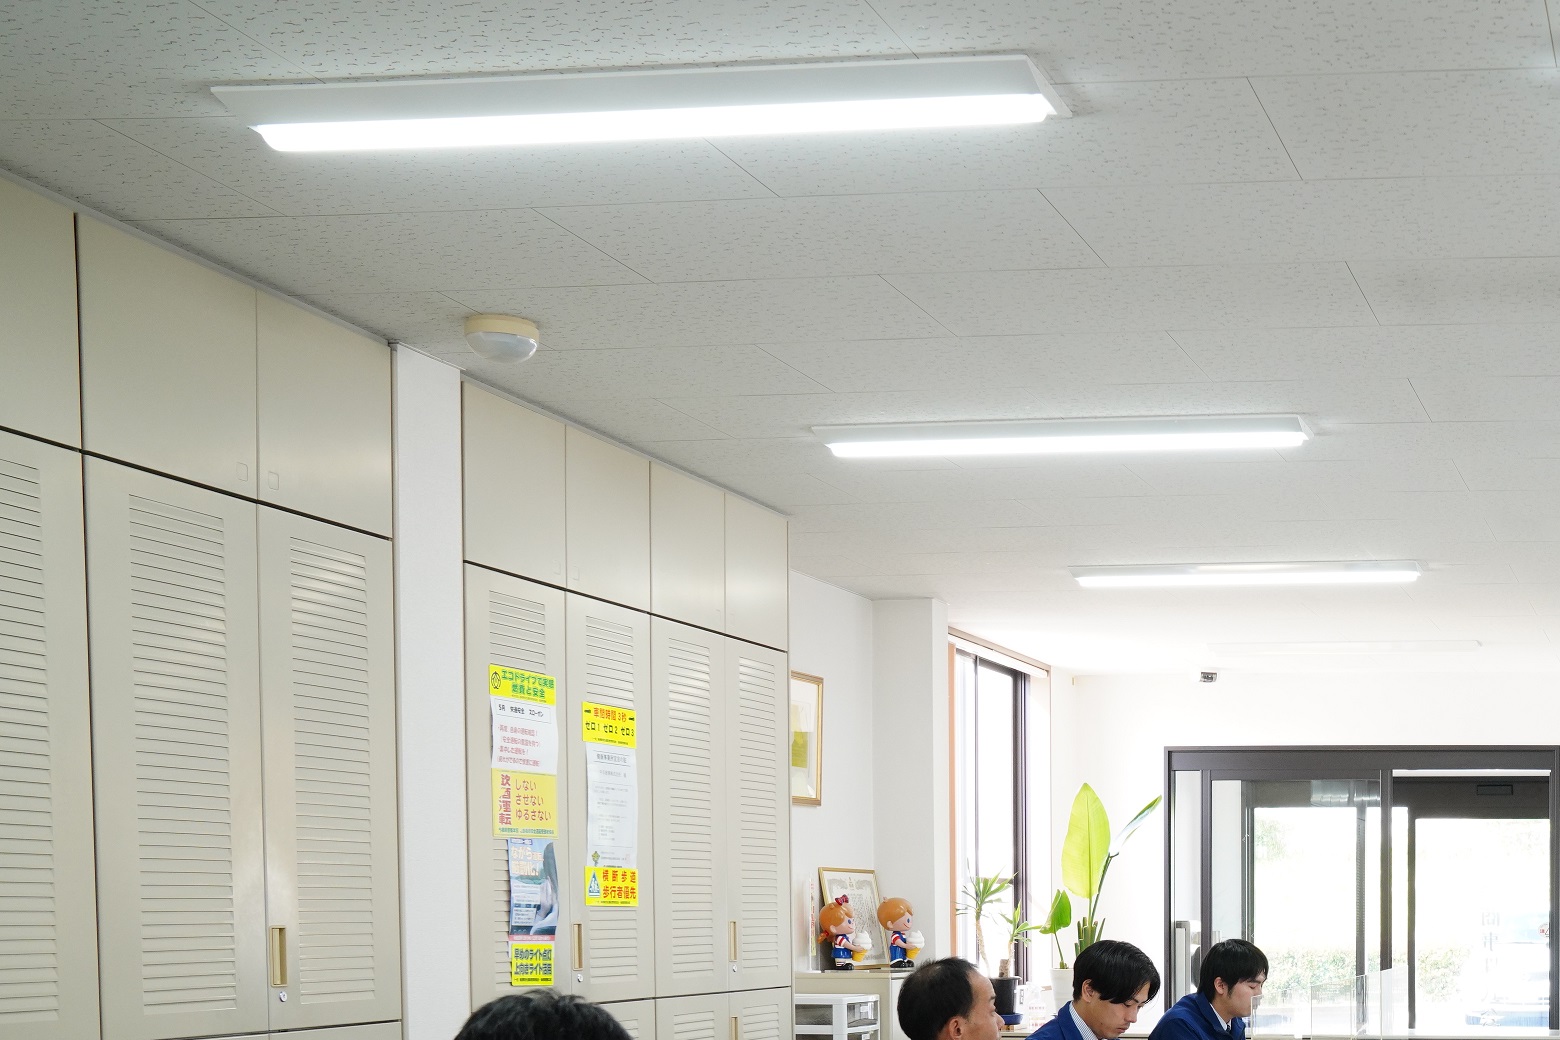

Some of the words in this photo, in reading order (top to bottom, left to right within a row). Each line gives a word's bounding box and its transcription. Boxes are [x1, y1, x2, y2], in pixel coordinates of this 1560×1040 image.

[515, 779, 537, 791] しない
[515, 794, 544, 806] させない
[515, 809, 552, 822] ゆるさない
[602, 869, 636, 884] 横断歩道
[602, 886, 637, 900] 歩行者優先
[514, 948, 552, 962] 早めのライト点灯
